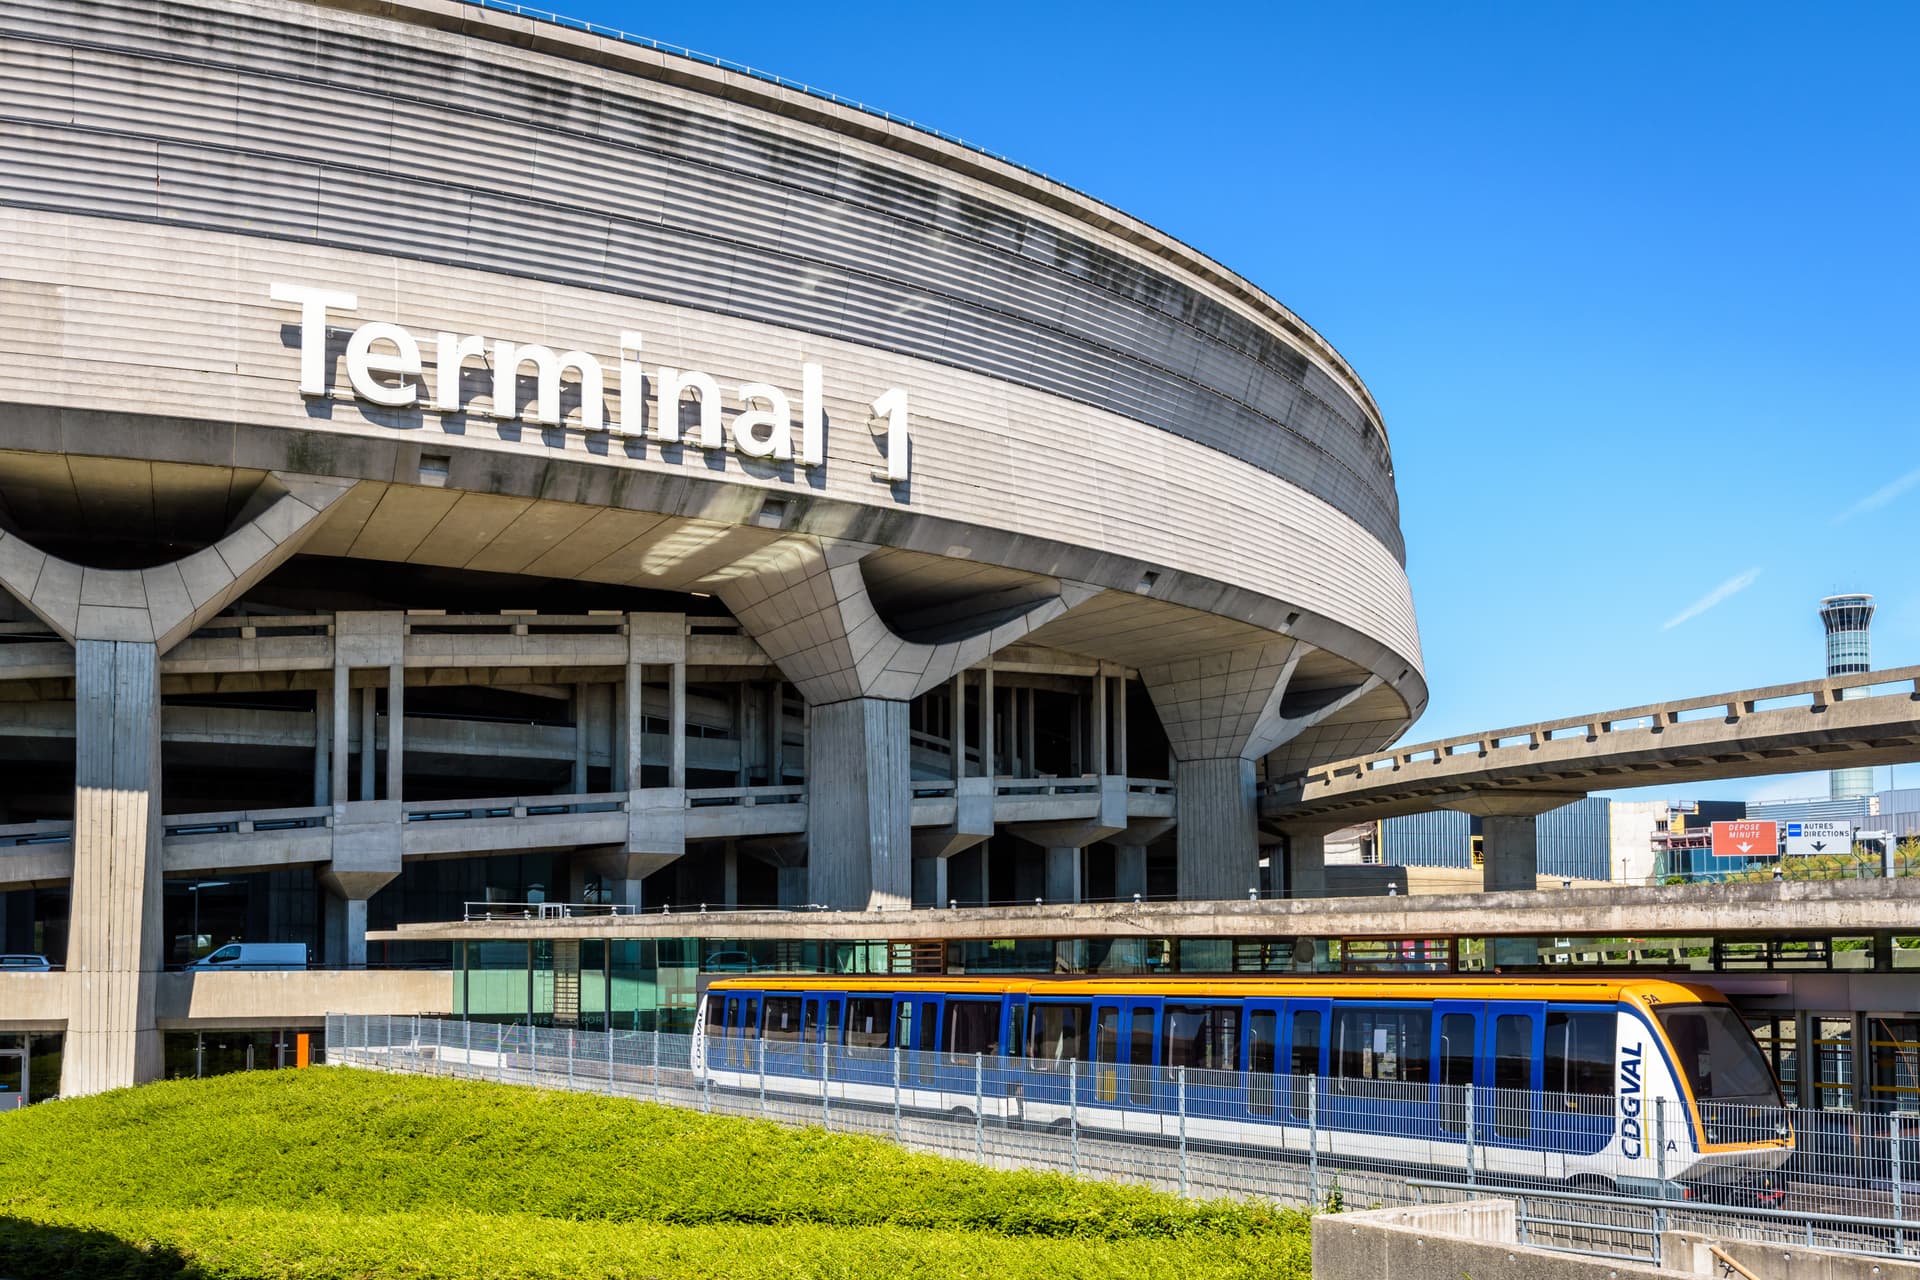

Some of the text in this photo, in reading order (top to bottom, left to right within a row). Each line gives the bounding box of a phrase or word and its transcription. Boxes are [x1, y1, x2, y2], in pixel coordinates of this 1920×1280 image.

[270, 282, 909, 481] Terminal 1
[1728, 831, 1761, 839] MINUTE
[1641, 994, 1662, 1005] 5A
[1620, 1042, 1642, 1160] CDGVAL
